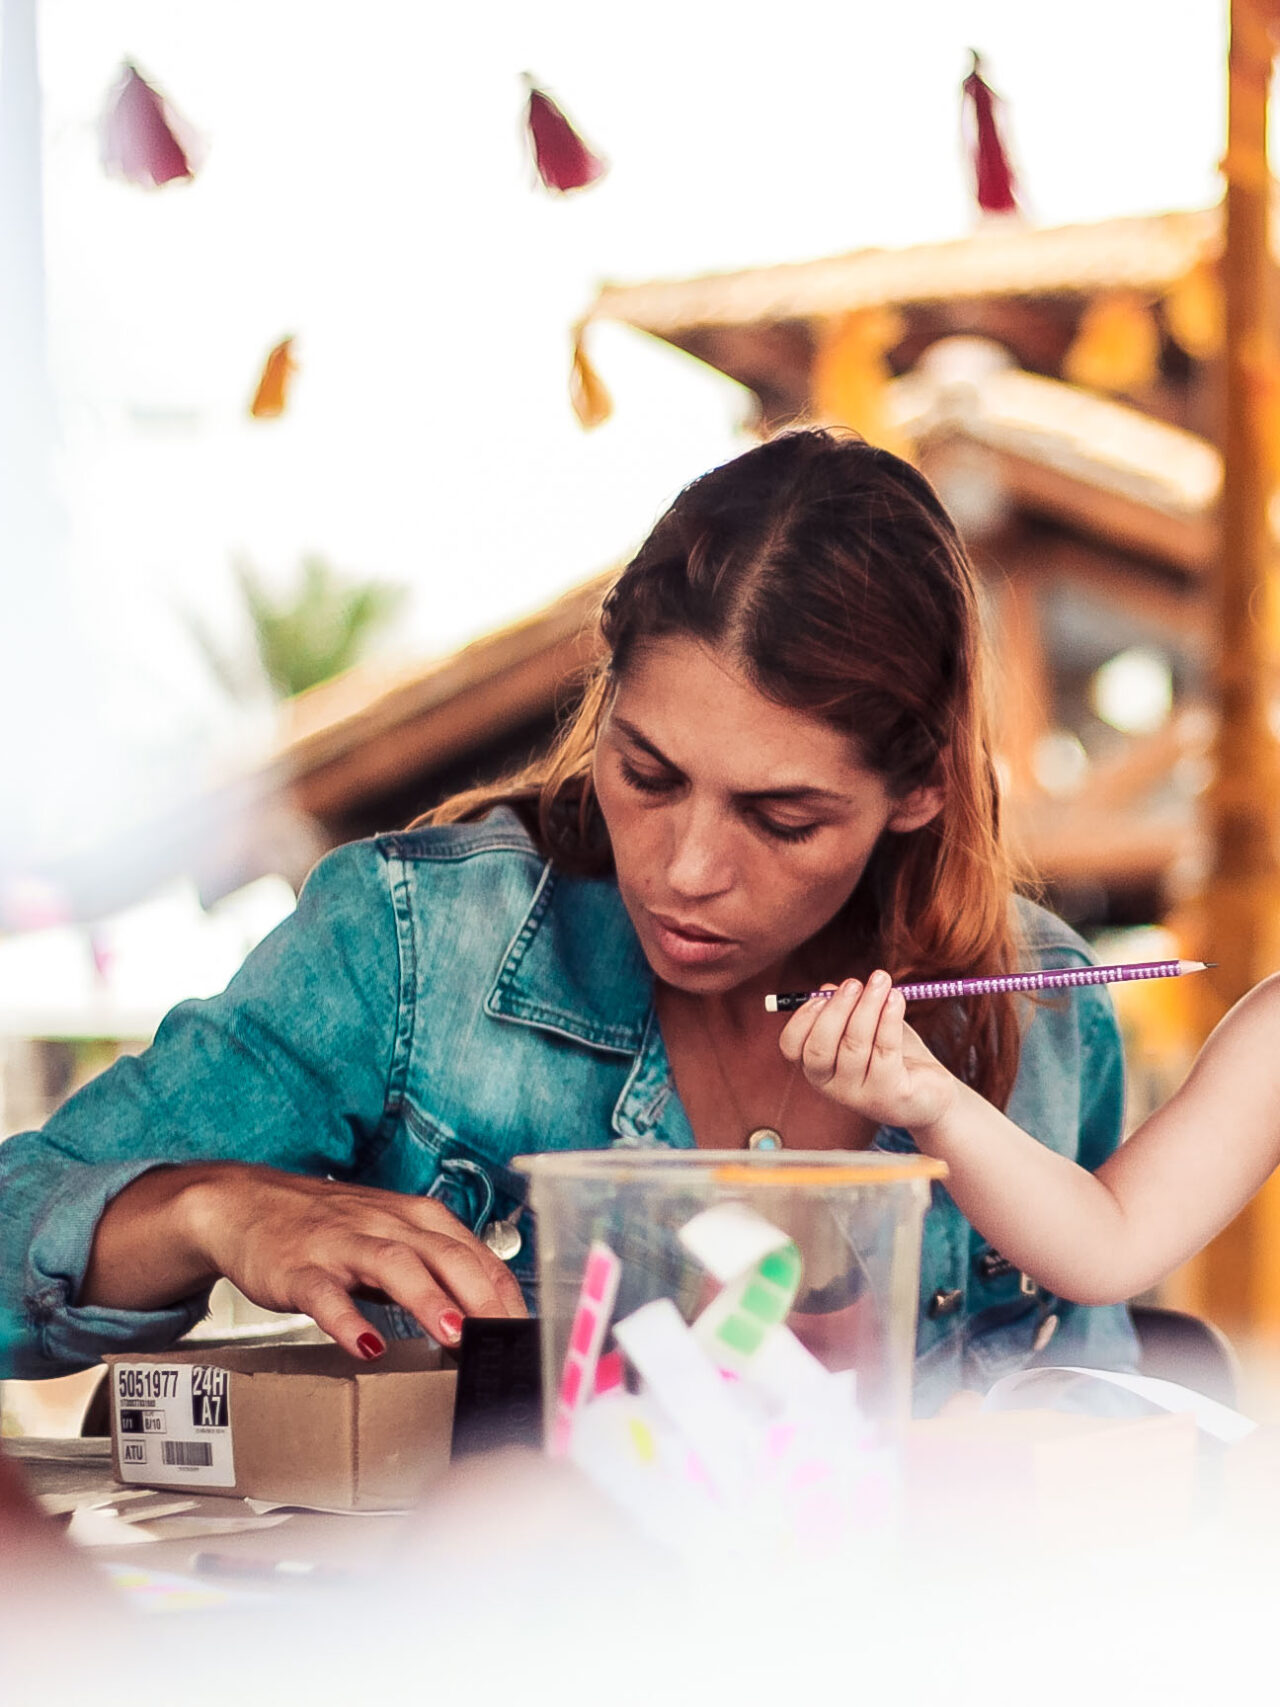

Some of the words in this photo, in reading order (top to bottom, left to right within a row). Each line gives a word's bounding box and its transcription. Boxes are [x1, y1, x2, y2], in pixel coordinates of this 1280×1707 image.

[119, 1370, 178, 1397] 5051977
[193, 1367, 223, 1395] 24H
[202, 1396, 221, 1425] A7
[125, 1445, 143, 1460] ATU
